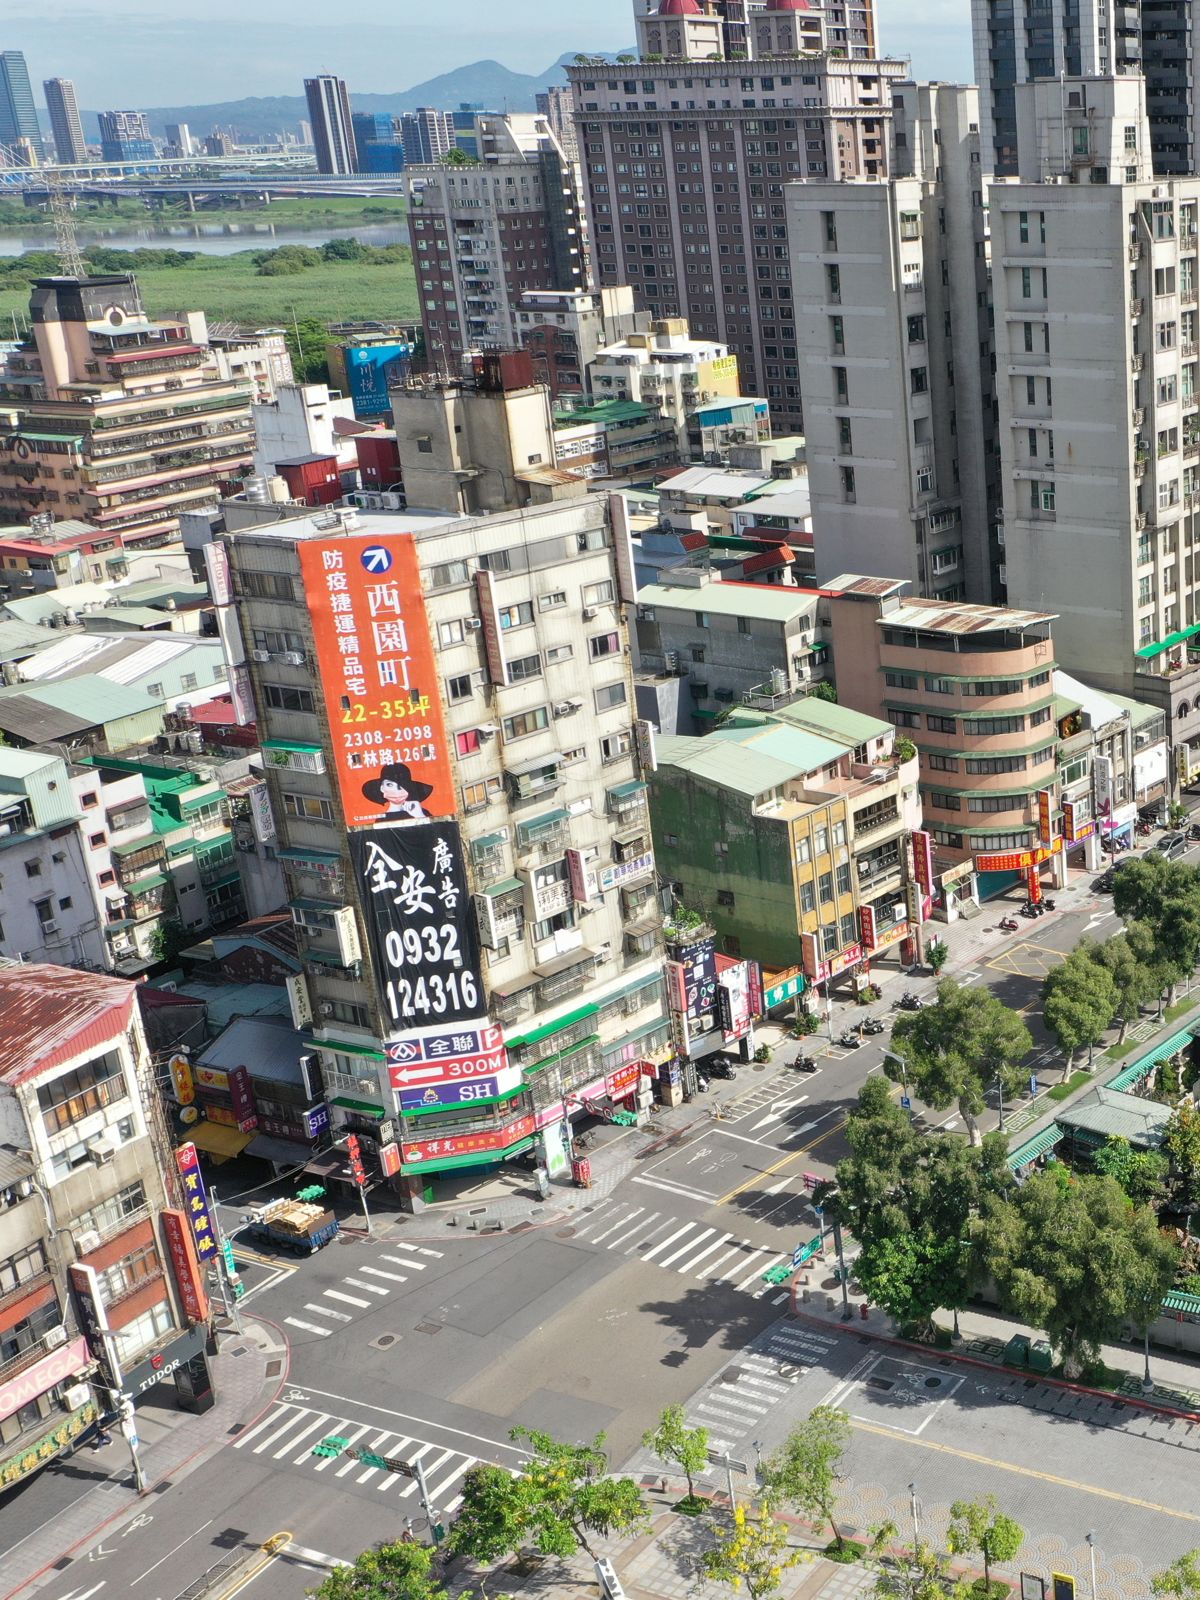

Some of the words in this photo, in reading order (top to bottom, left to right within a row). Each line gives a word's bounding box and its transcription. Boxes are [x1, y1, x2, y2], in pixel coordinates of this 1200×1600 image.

[321, 549, 368, 696] 防疫捷運精品宅
[364, 580, 412, 691] 西園町
[343, 725, 432, 747] 2308-2098
[364, 841, 436, 915] 全安
[432, 837, 460, 909] 廣告
[385, 923, 463, 968] 0932
[386, 970, 477, 1019] 124316
[428, 1034, 475, 1056] 全聯
[485, 1028, 499, 1048] P
[448, 1054, 502, 1076] 300M
[459, 1083, 494, 1101] SH
[309, 1111, 328, 1131] SH
[0, 1353, 81, 1412] OMEGA
[139, 1358, 181, 1392] TUDOR
